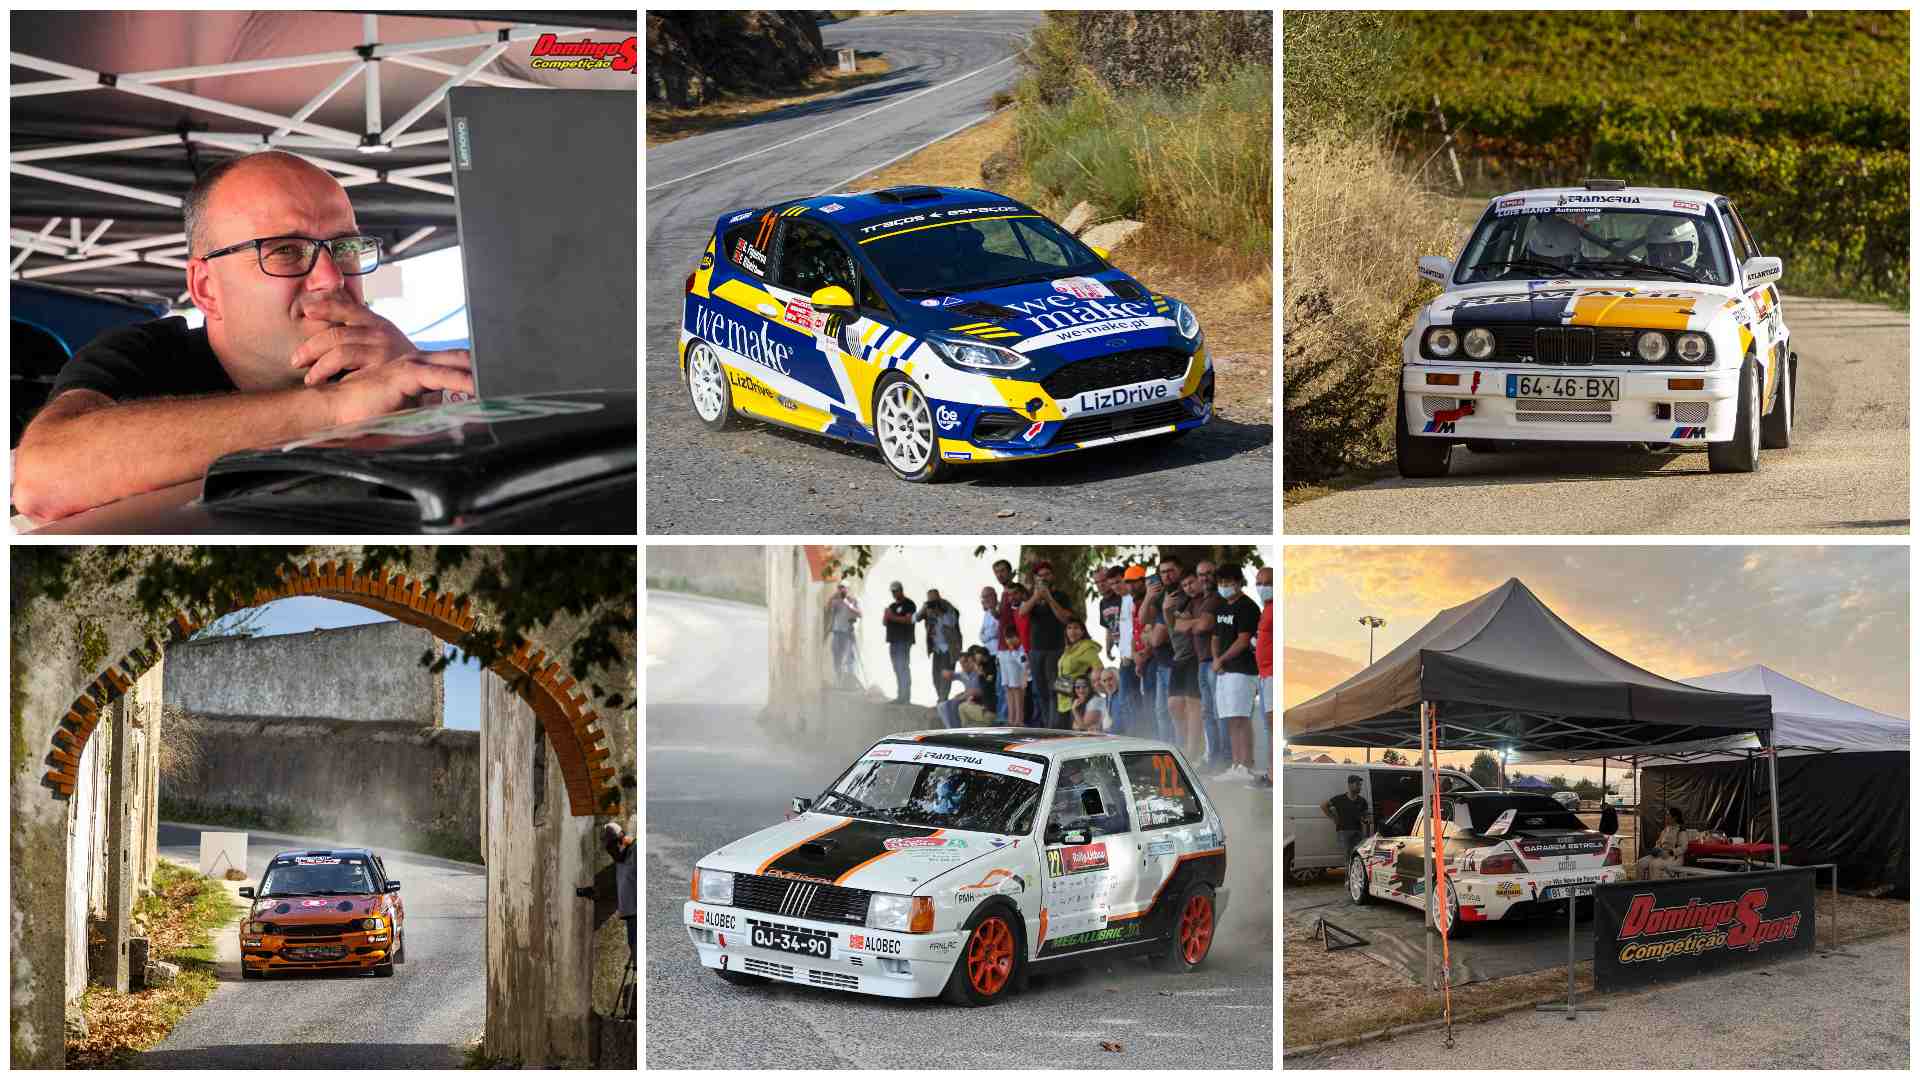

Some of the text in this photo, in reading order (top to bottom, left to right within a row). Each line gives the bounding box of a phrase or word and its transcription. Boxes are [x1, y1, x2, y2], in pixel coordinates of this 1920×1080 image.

[532, 59, 610, 70] Competição
[458, 121, 470, 167] Lenovo
[754, 211, 776, 251] 11
[1005, 292, 1073, 316] we
[1028, 301, 1148, 333] make
[1056, 320, 1149, 344] we-make.pt
[730, 372, 774, 399] LizDrive
[1080, 382, 1168, 413] LizDrive
[705, 911, 736, 930] ALOBEC
[754, 929, 827, 956] QJ-34-90
[864, 936, 901, 955] ALOBEC
[1619, 930, 1728, 964] Competição
